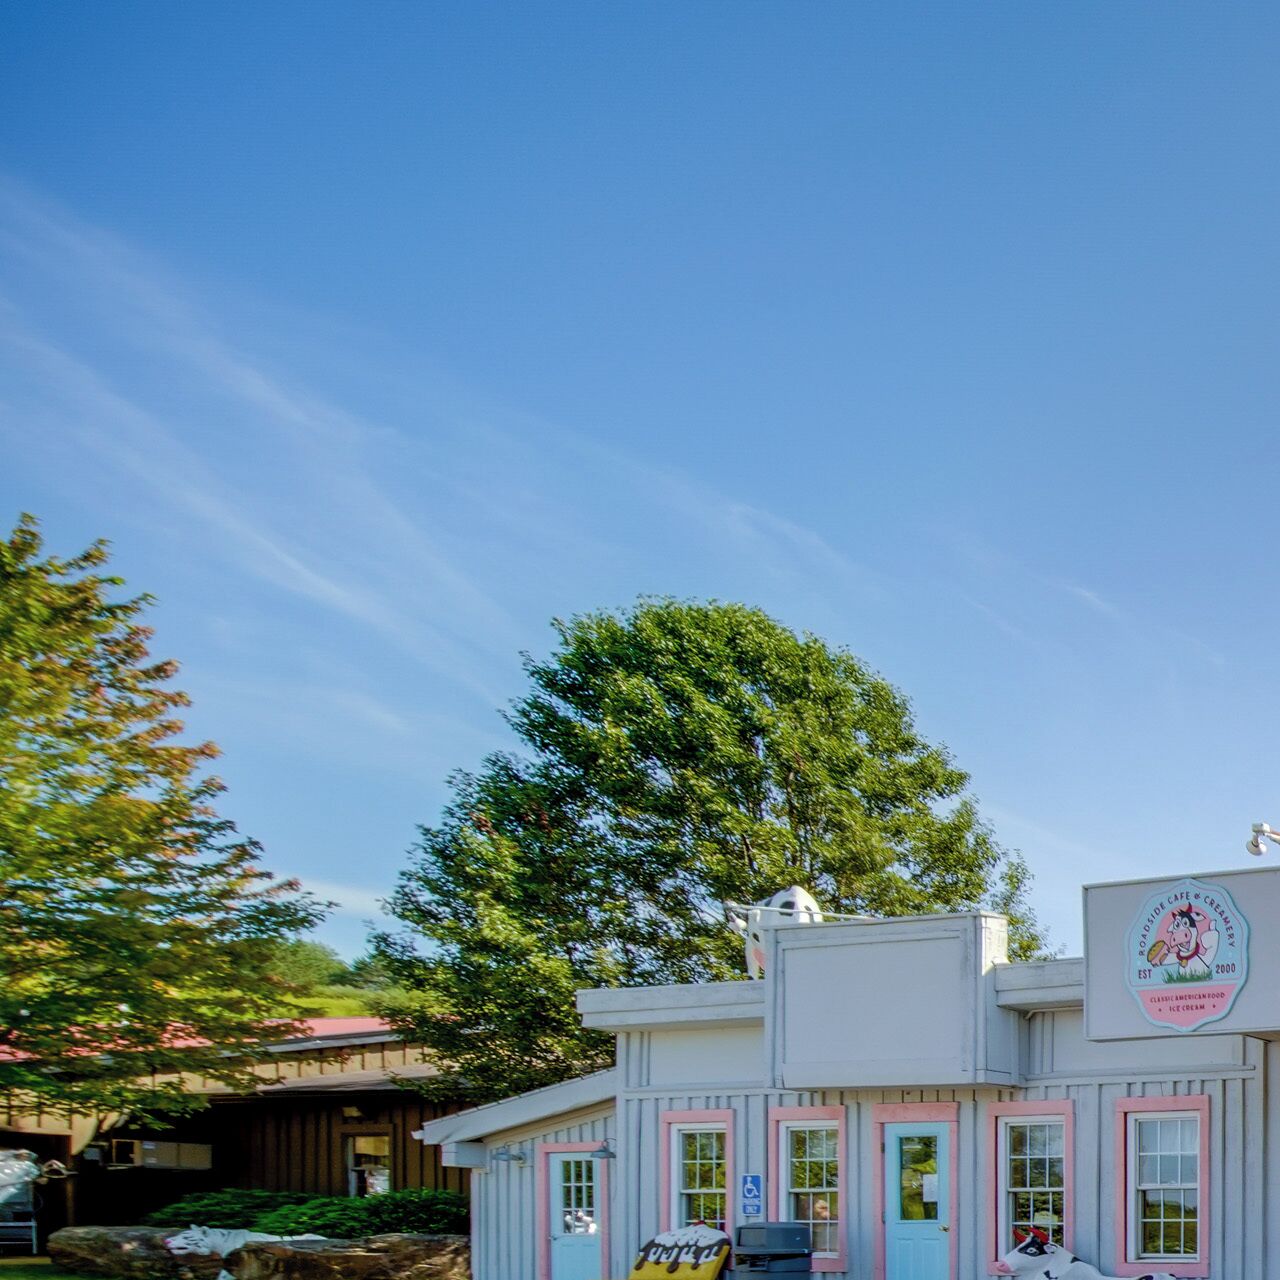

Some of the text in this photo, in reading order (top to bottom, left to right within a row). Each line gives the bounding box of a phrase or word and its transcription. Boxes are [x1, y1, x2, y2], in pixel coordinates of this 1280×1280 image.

[1138, 900, 1166, 957] ROADSIDE
[1167, 891, 1191, 905] CAFE
[1203, 895, 1235, 948] CREAMERY
[1138, 963, 1236, 980] EST 2000
[1150, 995, 1174, 1003] CLASSIC
[1175, 993, 1206, 1001] AMERICAN
[1182, 1003, 1205, 1012] CREAM
